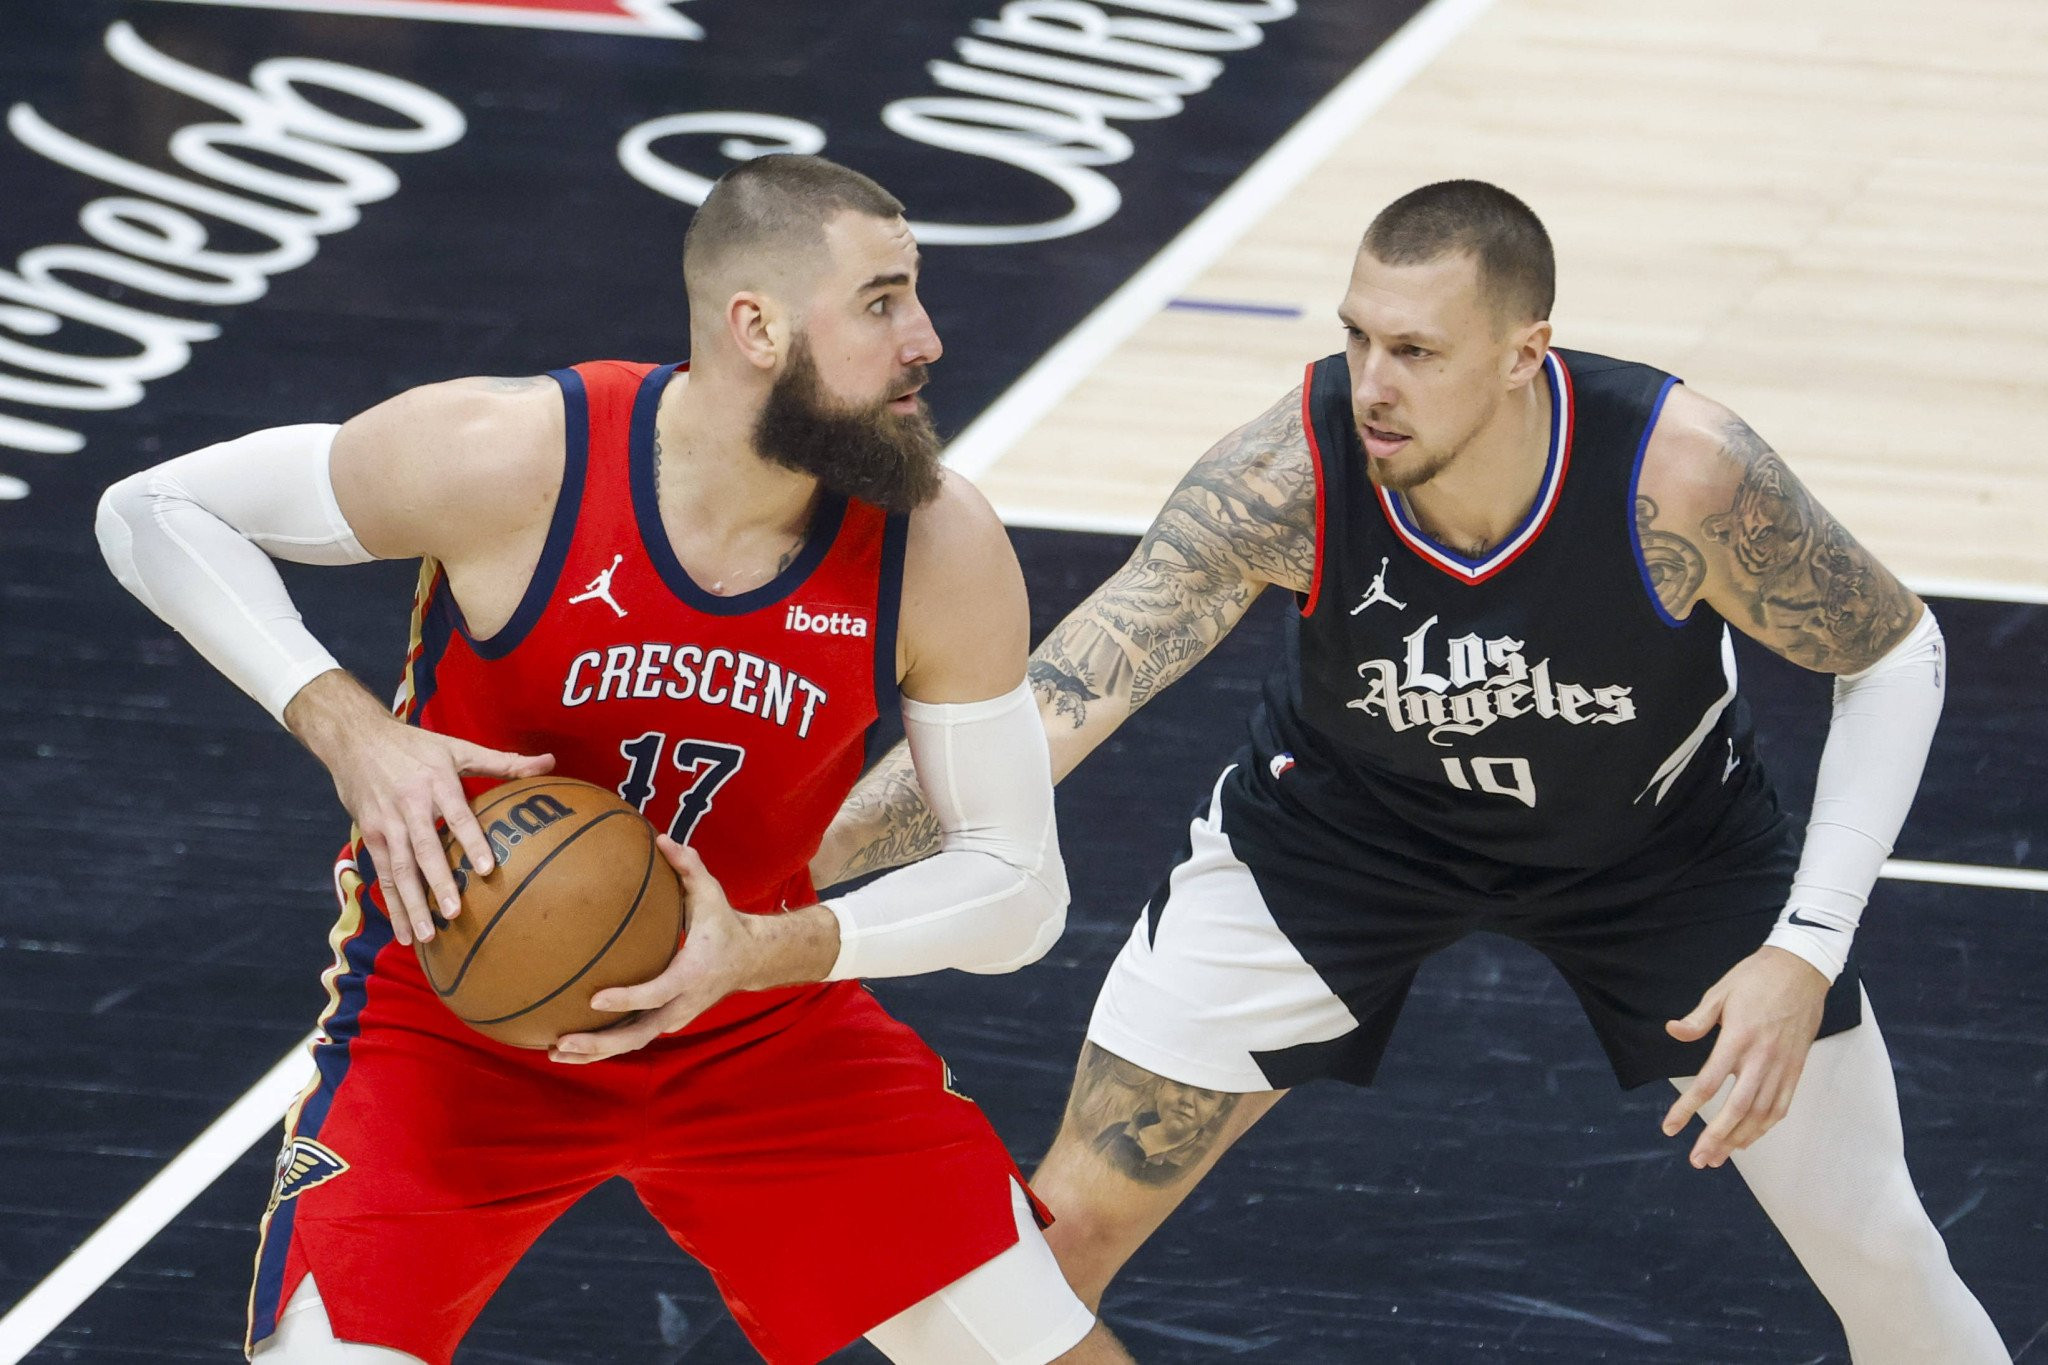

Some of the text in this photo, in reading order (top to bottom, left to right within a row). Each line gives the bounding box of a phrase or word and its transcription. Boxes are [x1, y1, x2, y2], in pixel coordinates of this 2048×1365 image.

[785, 605, 868, 638] ibotta
[1398, 614, 1530, 695] Los
[561, 642, 828, 739] CRESCENT
[1345, 657, 1637, 747] Angeles
[617, 731, 746, 848] 17
[1440, 756, 1537, 808] 10
